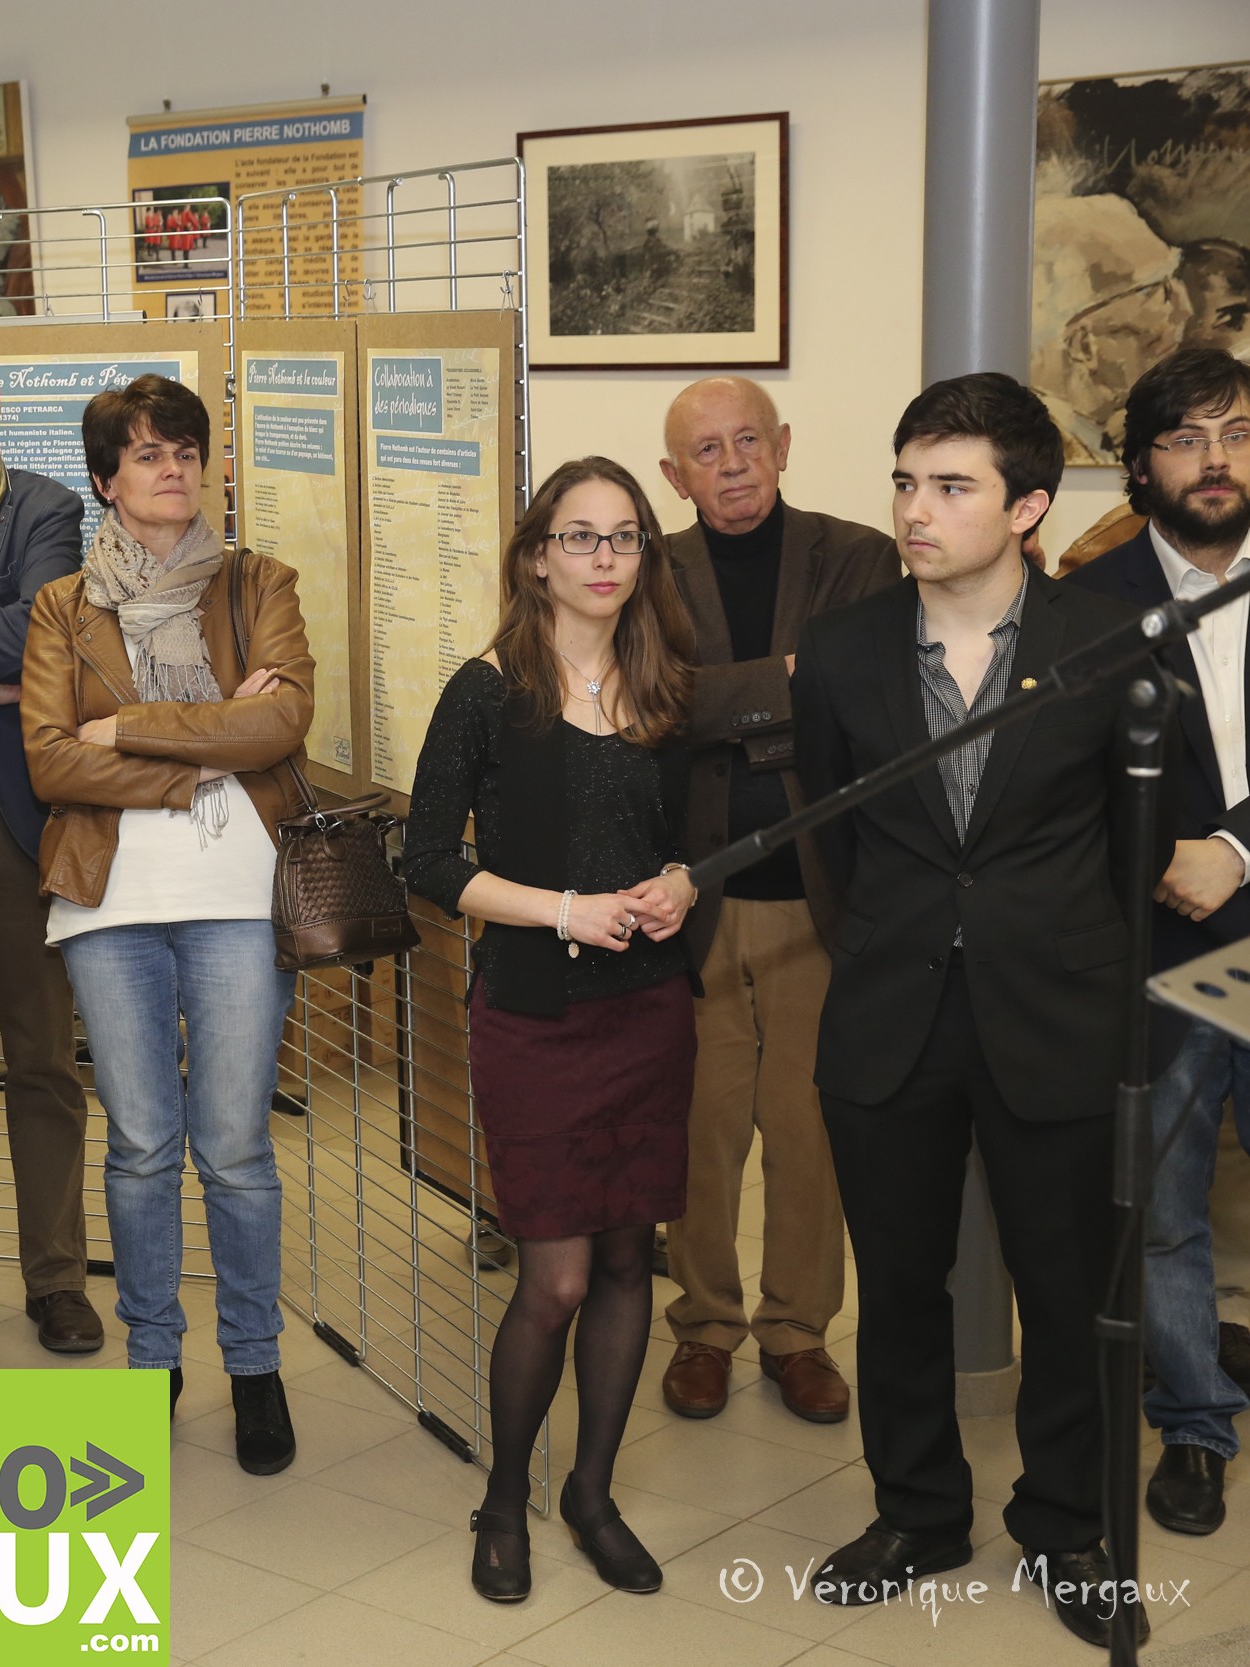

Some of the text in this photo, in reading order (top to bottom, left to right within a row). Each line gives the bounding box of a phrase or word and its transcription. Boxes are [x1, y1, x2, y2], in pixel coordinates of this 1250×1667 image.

[141, 119, 350, 151] LA FONDATION PIERRE NOTHOMB
[10, 367, 78, 389] Nothomb
[81, 376, 94, 387] et
[268, 362, 296, 385] Nothomb
[297, 374, 303, 385] et
[311, 370, 335, 386] couleur
[374, 364, 433, 388] Collaboration à
[375, 392, 388, 414] des
[391, 392, 436, 428] périodiques
